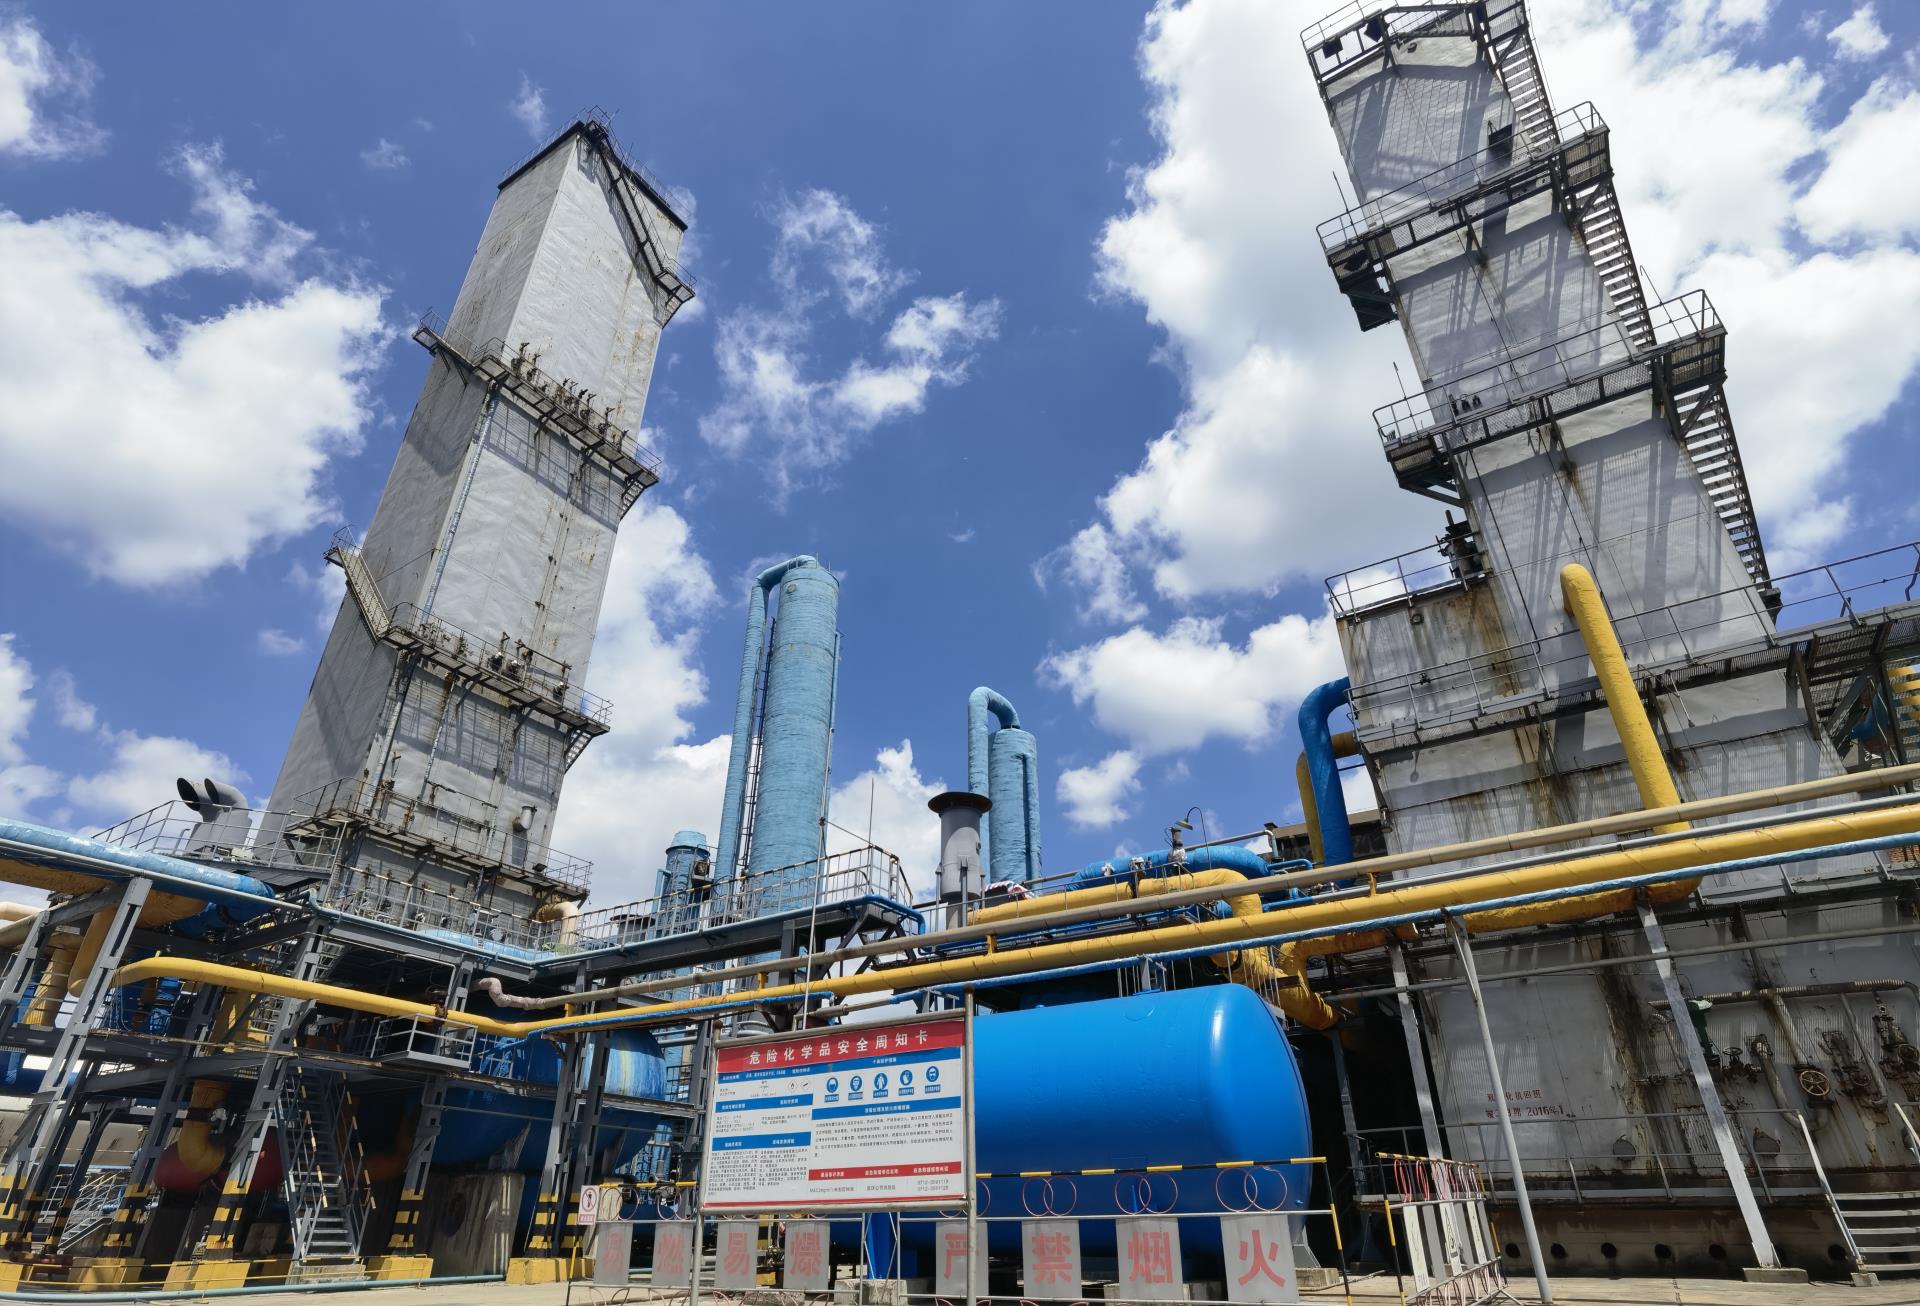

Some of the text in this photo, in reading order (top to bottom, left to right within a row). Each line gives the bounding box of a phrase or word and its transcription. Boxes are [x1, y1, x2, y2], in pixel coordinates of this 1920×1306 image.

[749, 1029, 928, 1065] 危险化学品安全周知卡
